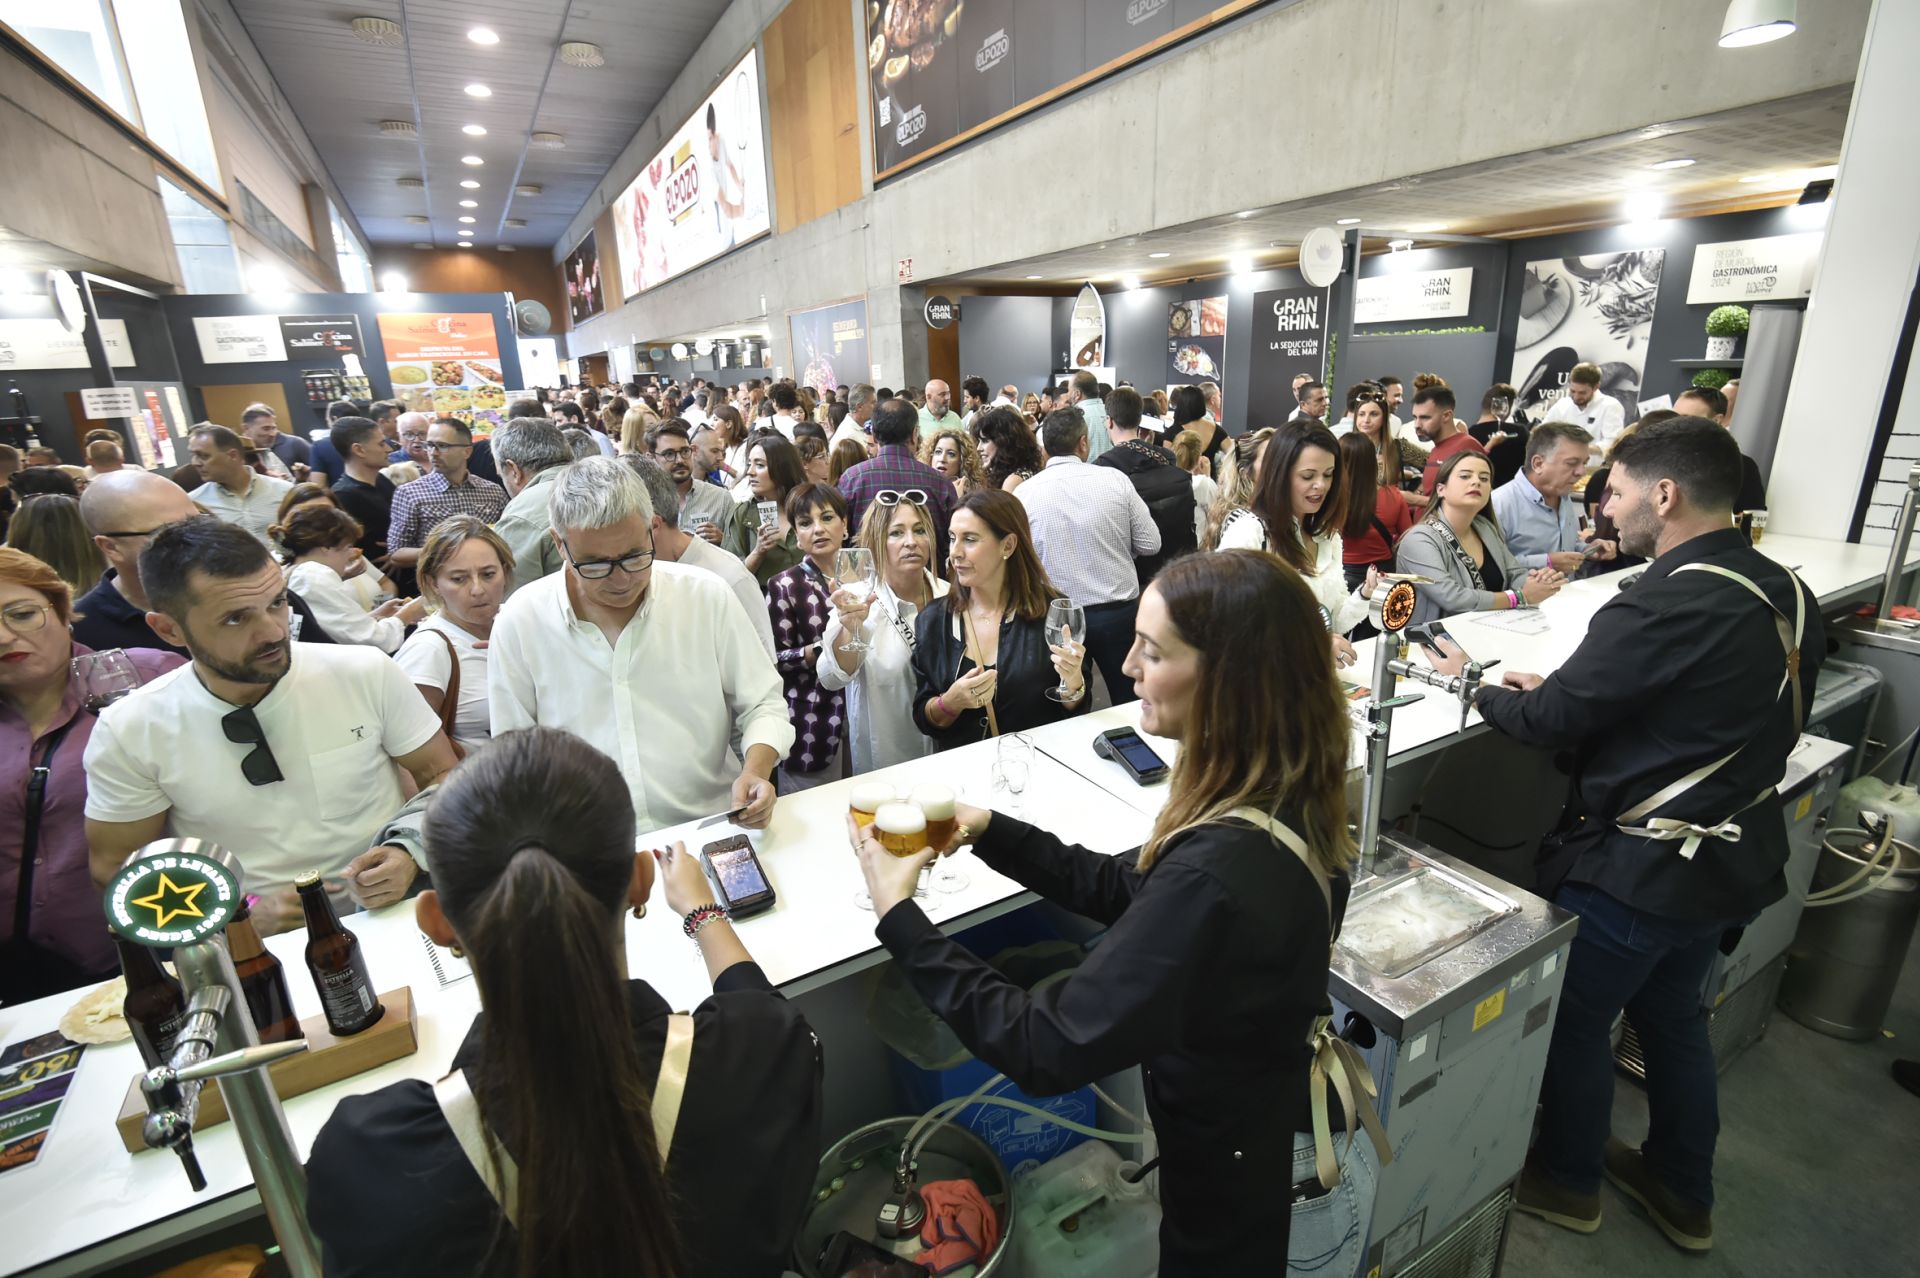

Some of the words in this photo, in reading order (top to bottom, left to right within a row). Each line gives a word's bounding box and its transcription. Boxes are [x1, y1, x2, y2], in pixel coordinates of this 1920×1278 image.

[1128, 0, 1166, 20] ELPOZ
[928, 304, 951, 313] GRAN
[1273, 295, 1318, 316] GRAN
[931, 311, 953, 320] RHIN.
[1277, 312, 1319, 332] RHIN.
[1270, 341, 1279, 350] LA
[1280, 338, 1318, 350] SEDUCCIÓN
[1287, 348, 1301, 357] DEL
[1301, 347, 1318, 356] MAR
[1557, 371, 1570, 386] U
[112, 865, 152, 927] ESTRELLA
[151, 857, 177, 871] DE
[180, 857, 231, 902] LEVANTE
